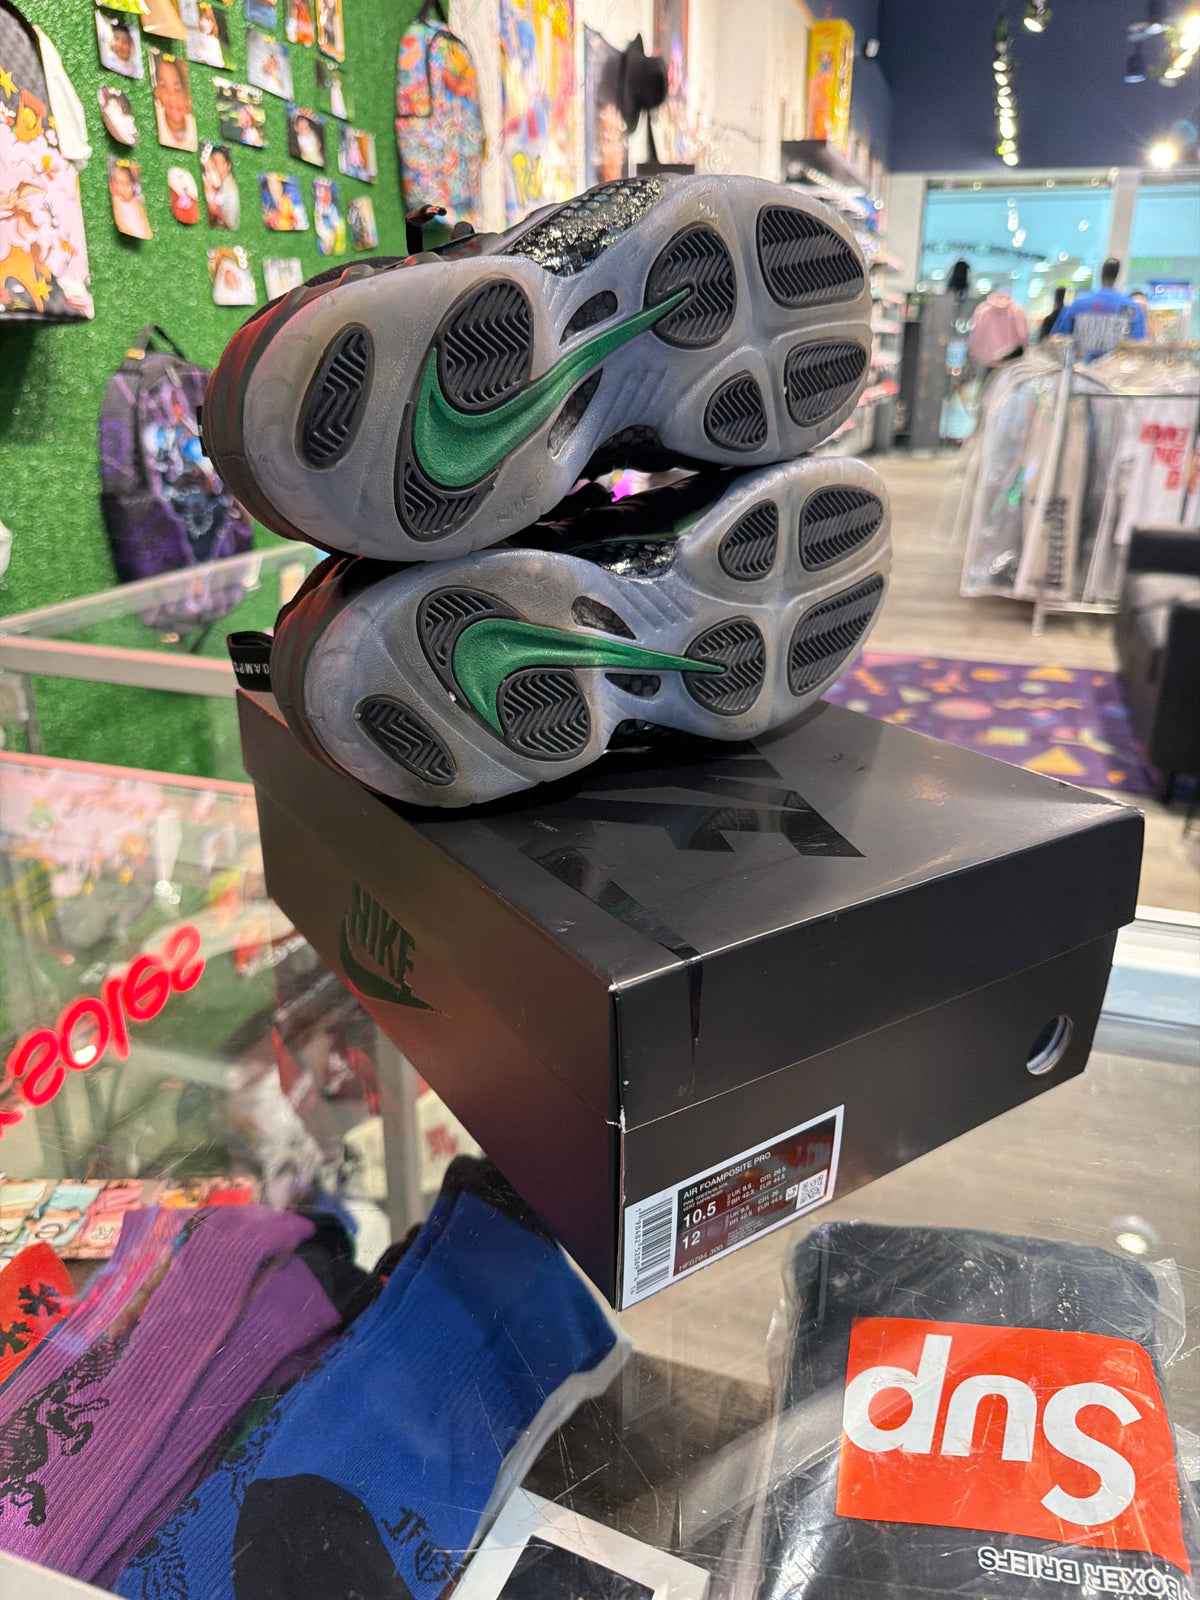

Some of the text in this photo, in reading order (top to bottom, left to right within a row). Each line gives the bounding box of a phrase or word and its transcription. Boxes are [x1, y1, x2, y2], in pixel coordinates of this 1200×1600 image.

[350, 880, 416, 990] NIKE
[683, 1151, 771, 1200] AIR FOAMPOSITE PRO
[683, 1200, 717, 1228] 10.5
[682, 1230, 701, 1250] 12
[842, 1334, 1142, 1526] Sup
[978, 1546, 1180, 1600] BOXER BRIEFS
